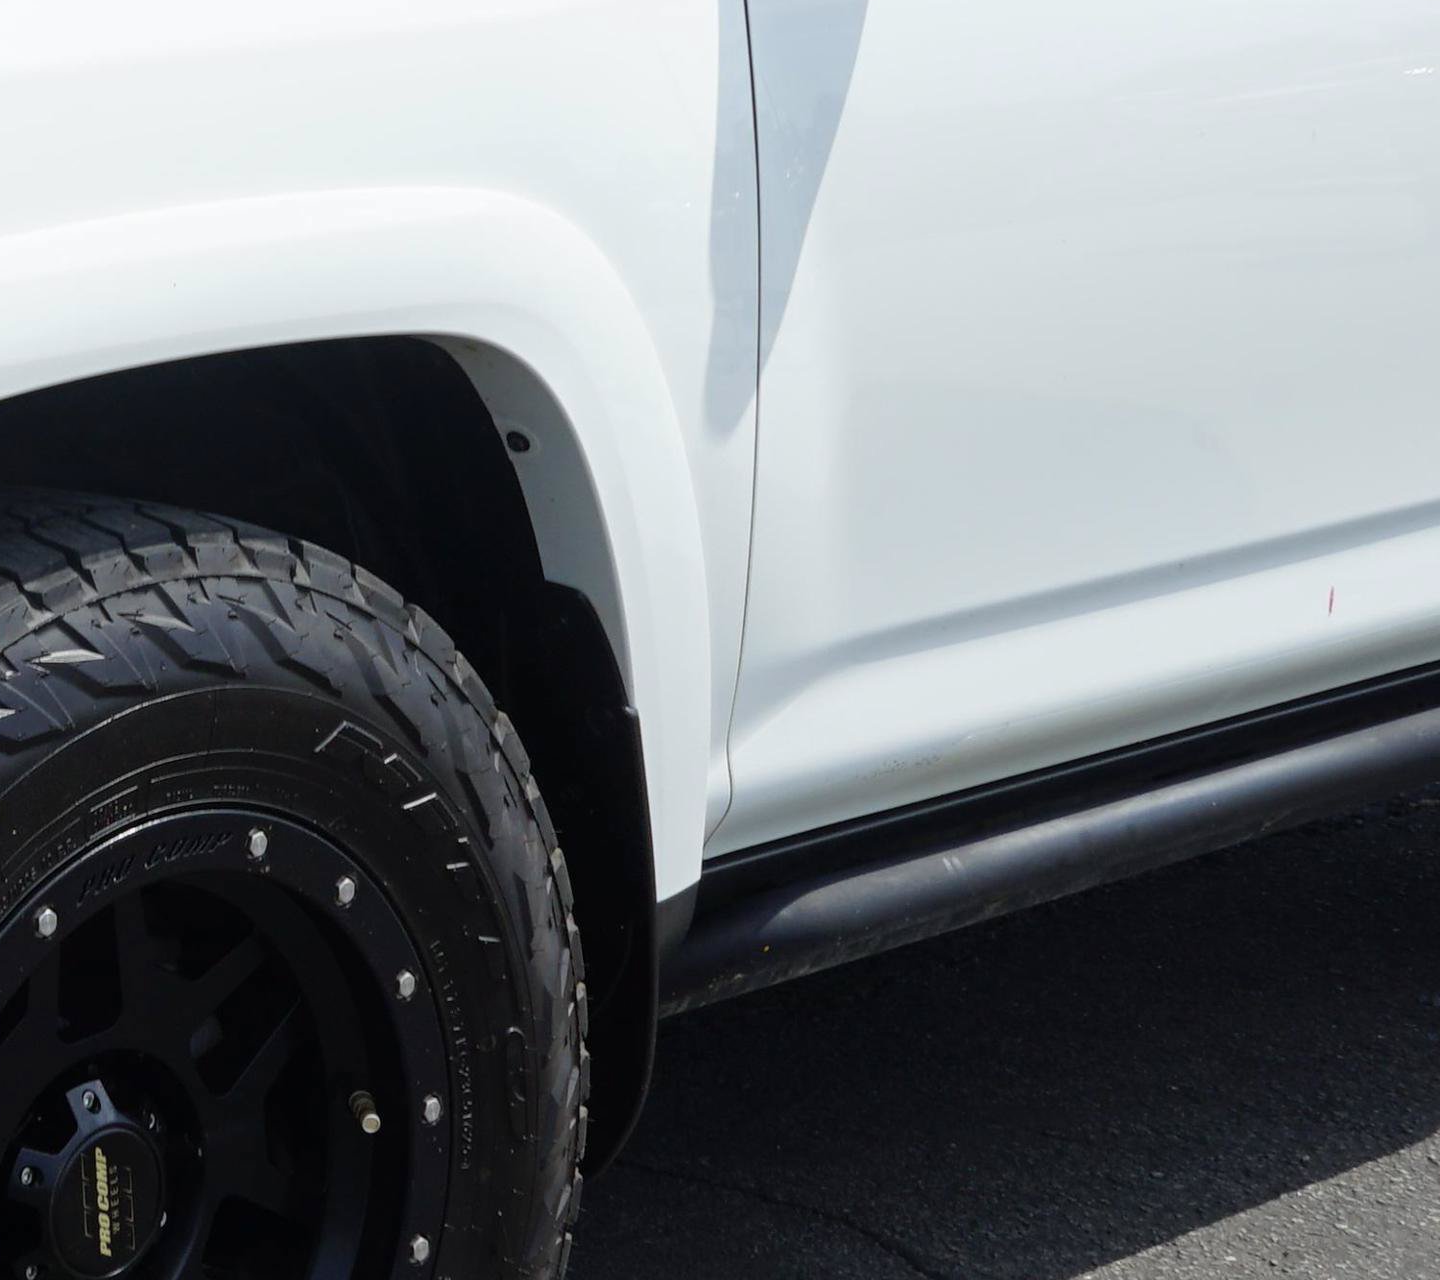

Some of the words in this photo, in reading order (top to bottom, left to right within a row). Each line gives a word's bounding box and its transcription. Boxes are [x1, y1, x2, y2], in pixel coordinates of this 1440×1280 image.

[94, 1145, 110, 1212] COMP
[109, 1164, 121, 1235] WHEELS
[96, 1212, 113, 1257] PRO
